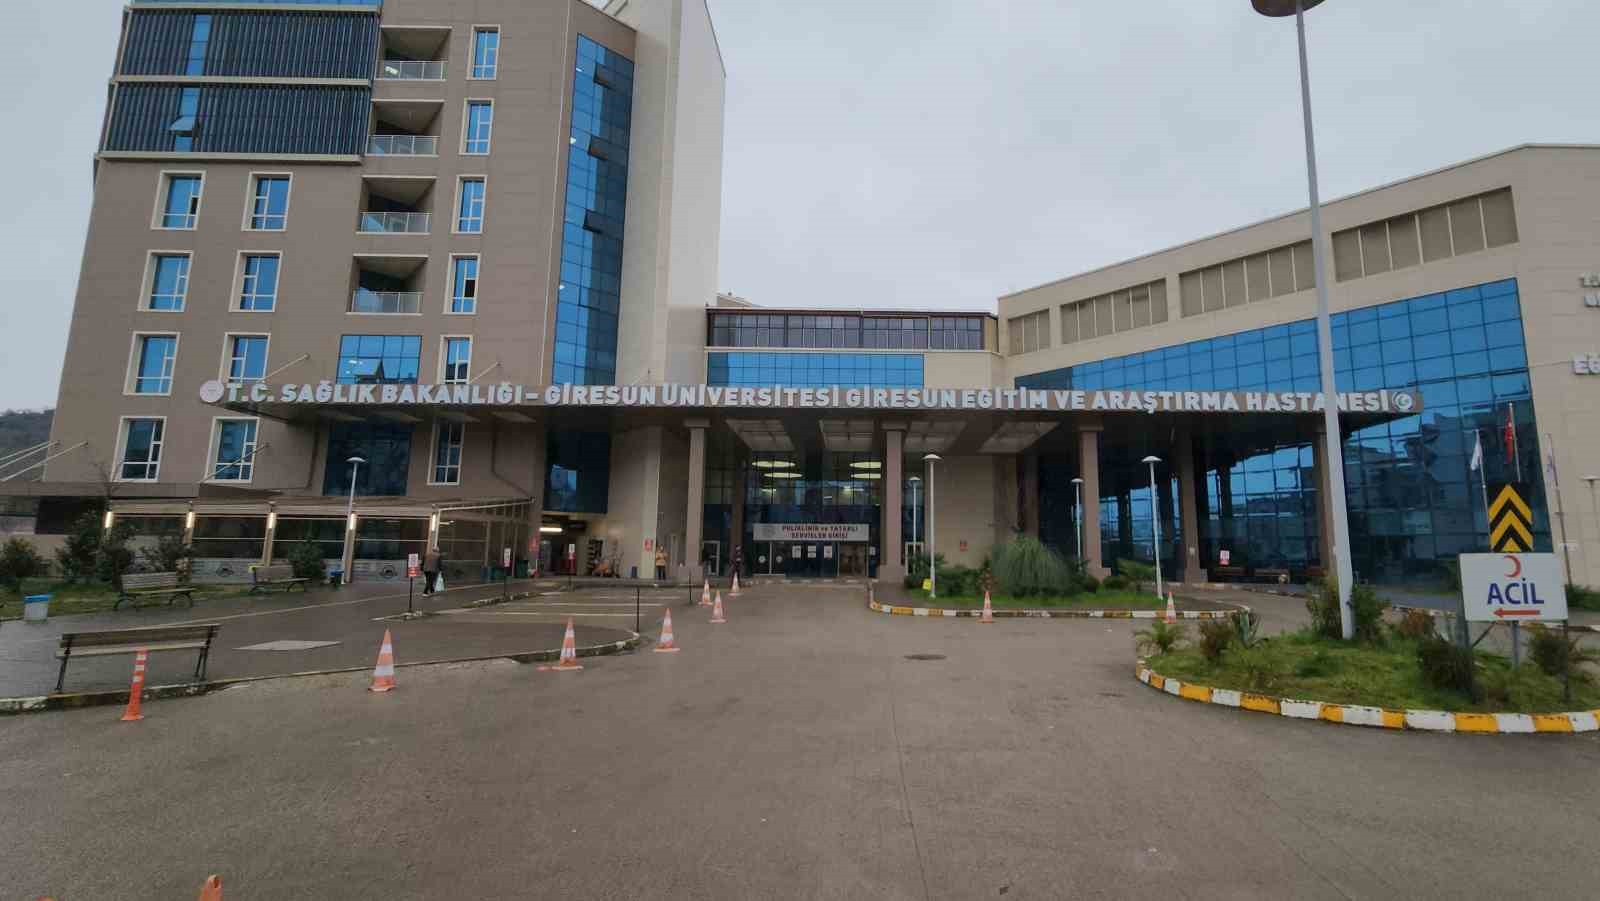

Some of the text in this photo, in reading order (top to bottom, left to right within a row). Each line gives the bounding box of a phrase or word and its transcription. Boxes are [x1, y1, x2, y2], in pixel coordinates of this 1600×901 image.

[281, 380, 377, 402] SAĞLIK
[544, 382, 656, 405] GİRESUN
[846, 383, 956, 408] GİRESUN
[962, 384, 1048, 410] EĞİTİM
[1054, 390, 1086, 410] VE
[1091, 390, 1239, 414] ARAŞTIRMA
[1487, 577, 1545, 605] ACİL
